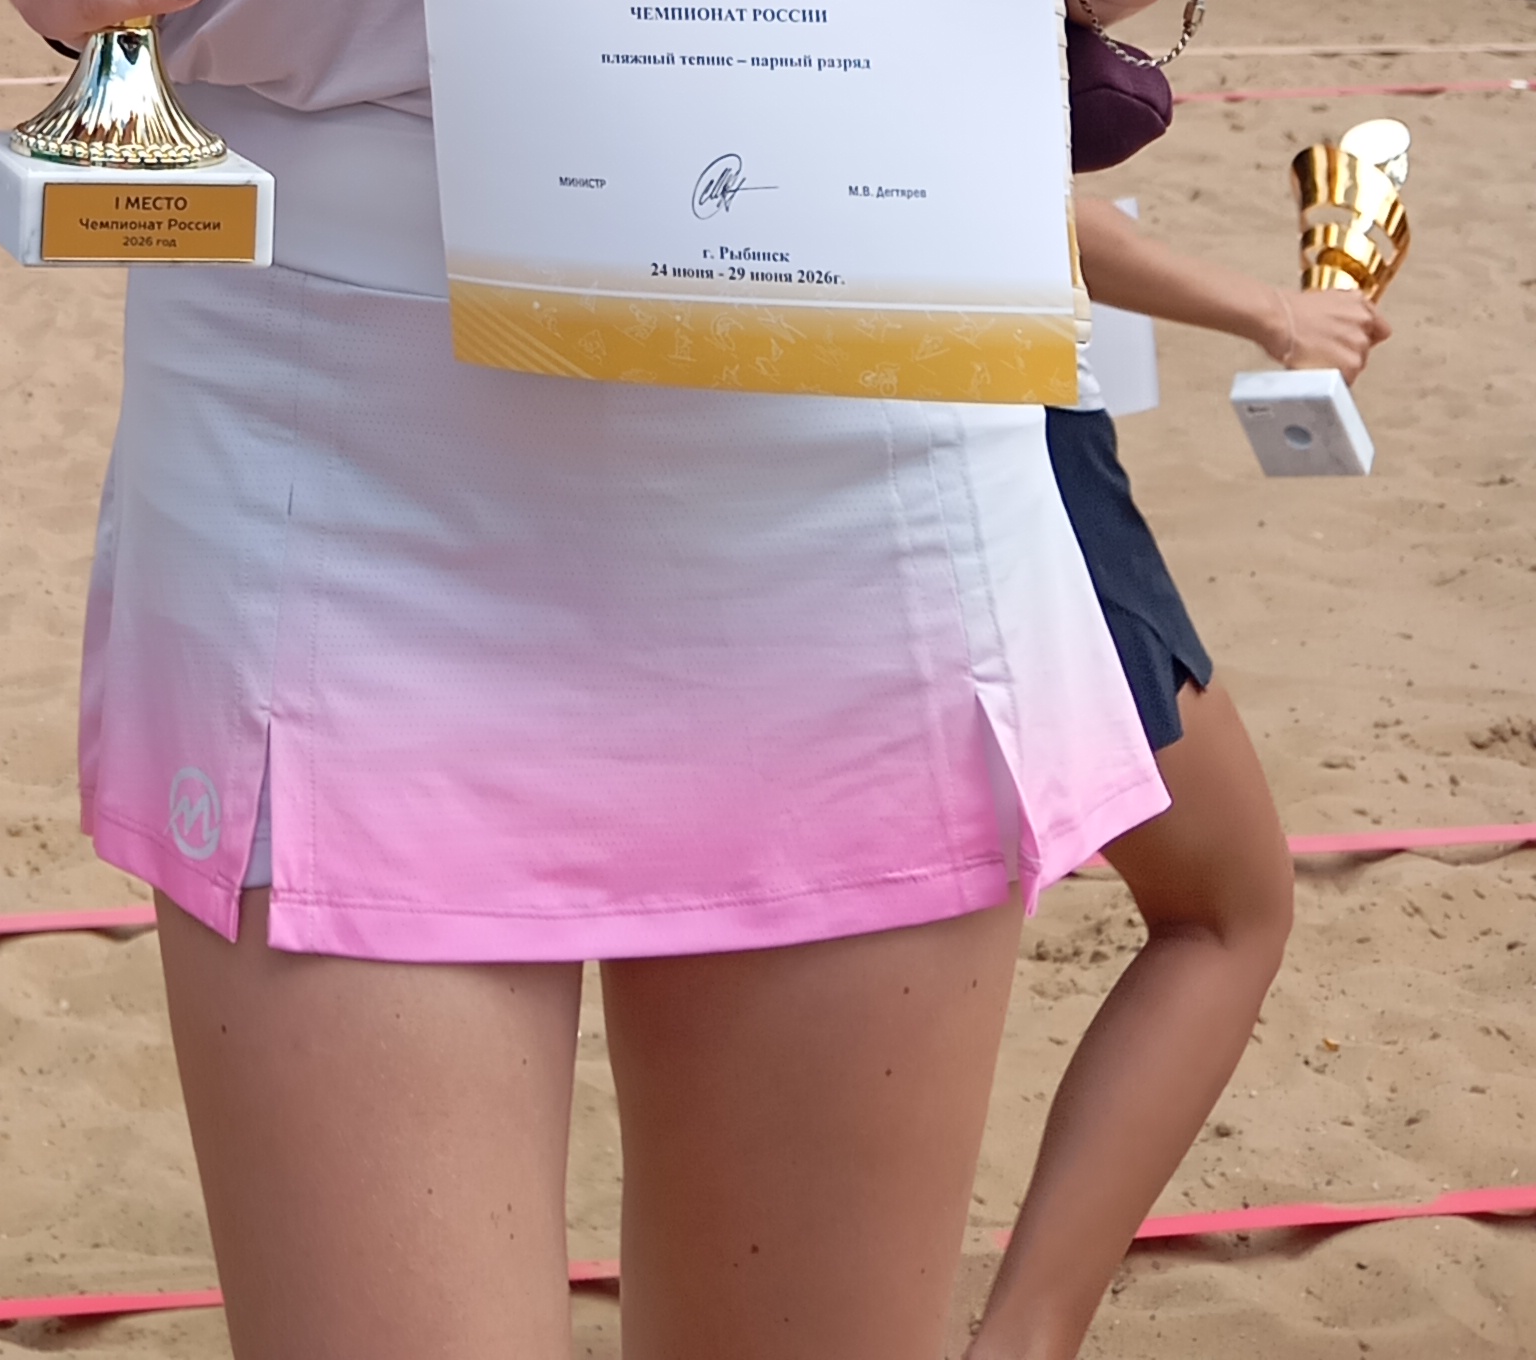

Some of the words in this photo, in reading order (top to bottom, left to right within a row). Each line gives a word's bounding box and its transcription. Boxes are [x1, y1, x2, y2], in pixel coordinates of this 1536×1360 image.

[630, 6, 748, 22] ЧЕМПИОНАТ
[752, 8, 828, 23] РОССИИ
[601, 52, 676, 65] пляжный
[679, 55, 734, 67] теннис
[750, 54, 813, 70] парный
[817, 58, 872, 72] разряд
[559, 176, 607, 189] МИНИСТР
[124, 196, 188, 211] МЕСТО
[79, 218, 164, 232] Чемпионат
[167, 218, 221, 232] России
[122, 236, 154, 248] 2026
[156, 237, 177, 249] год
[719, 246, 790, 263] Рыбинск
[650, 262, 668, 277] 24
[672, 266, 714, 279] июня
[728, 266, 746, 281] 29
[750, 270, 793, 284] июня
